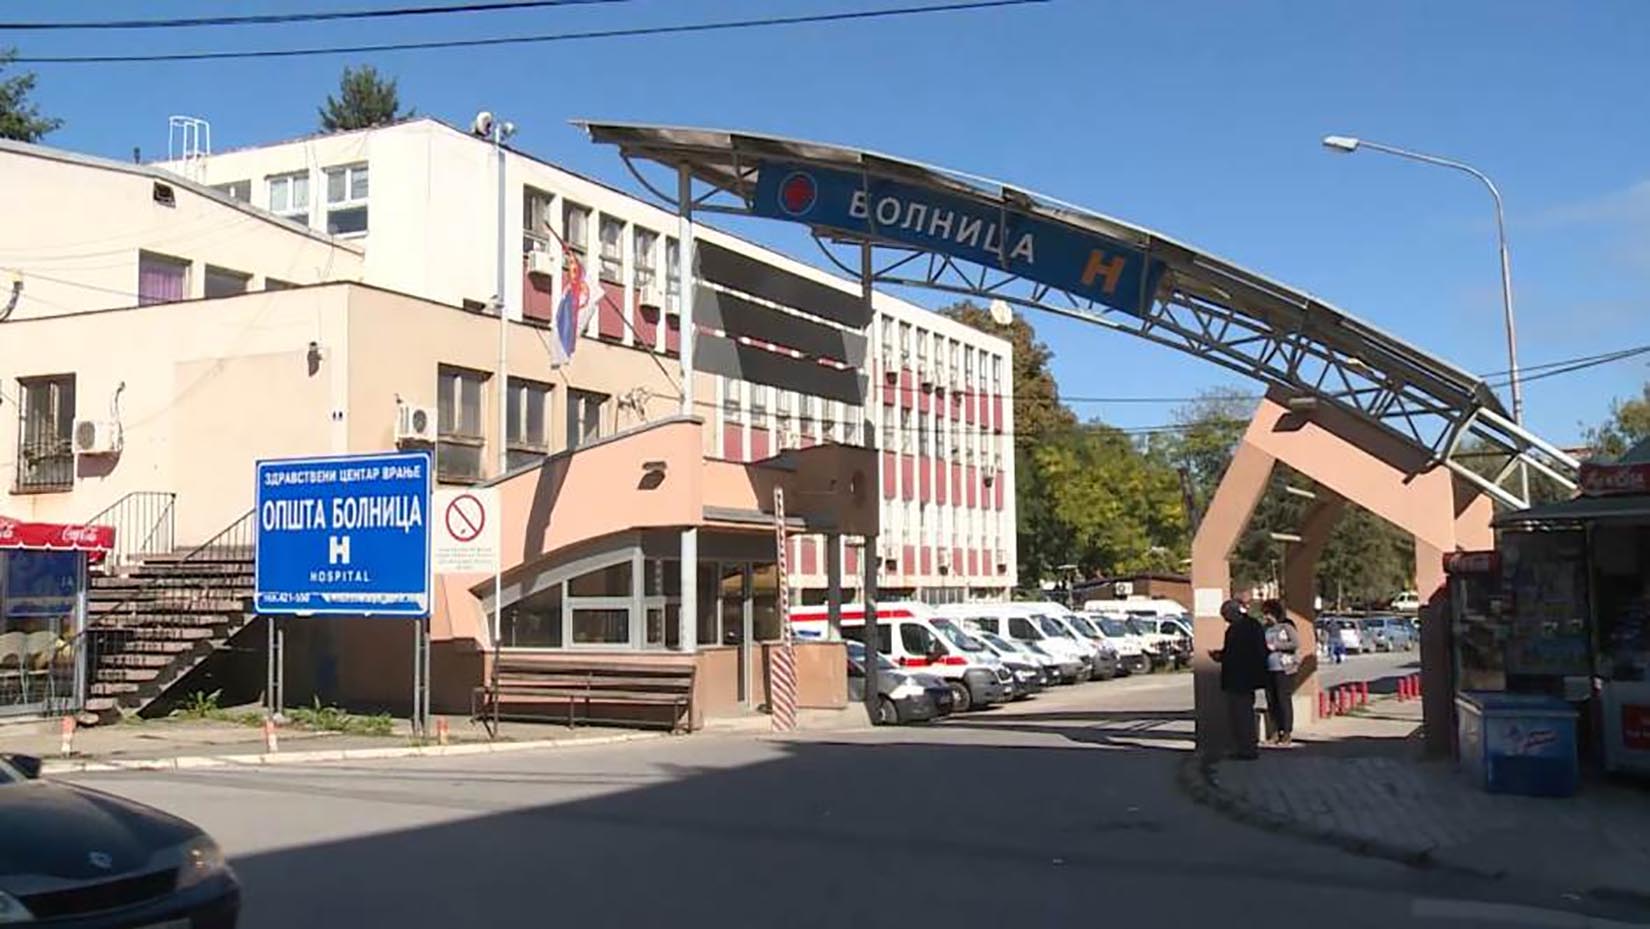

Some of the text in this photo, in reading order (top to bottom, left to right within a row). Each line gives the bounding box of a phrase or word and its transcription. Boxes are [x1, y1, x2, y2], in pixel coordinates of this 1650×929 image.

[849, 189, 1036, 263] БОЛНИЦА
[1082, 251, 1124, 293] H
[265, 465, 421, 486] ЗДРАВСТВЕНИ ЦЕНТАР ВРАЊЕ
[262, 495, 422, 533] ОПШТА БОЛНИЦА
[329, 535, 350, 565] H
[310, 570, 371, 583] HOSPITAL
